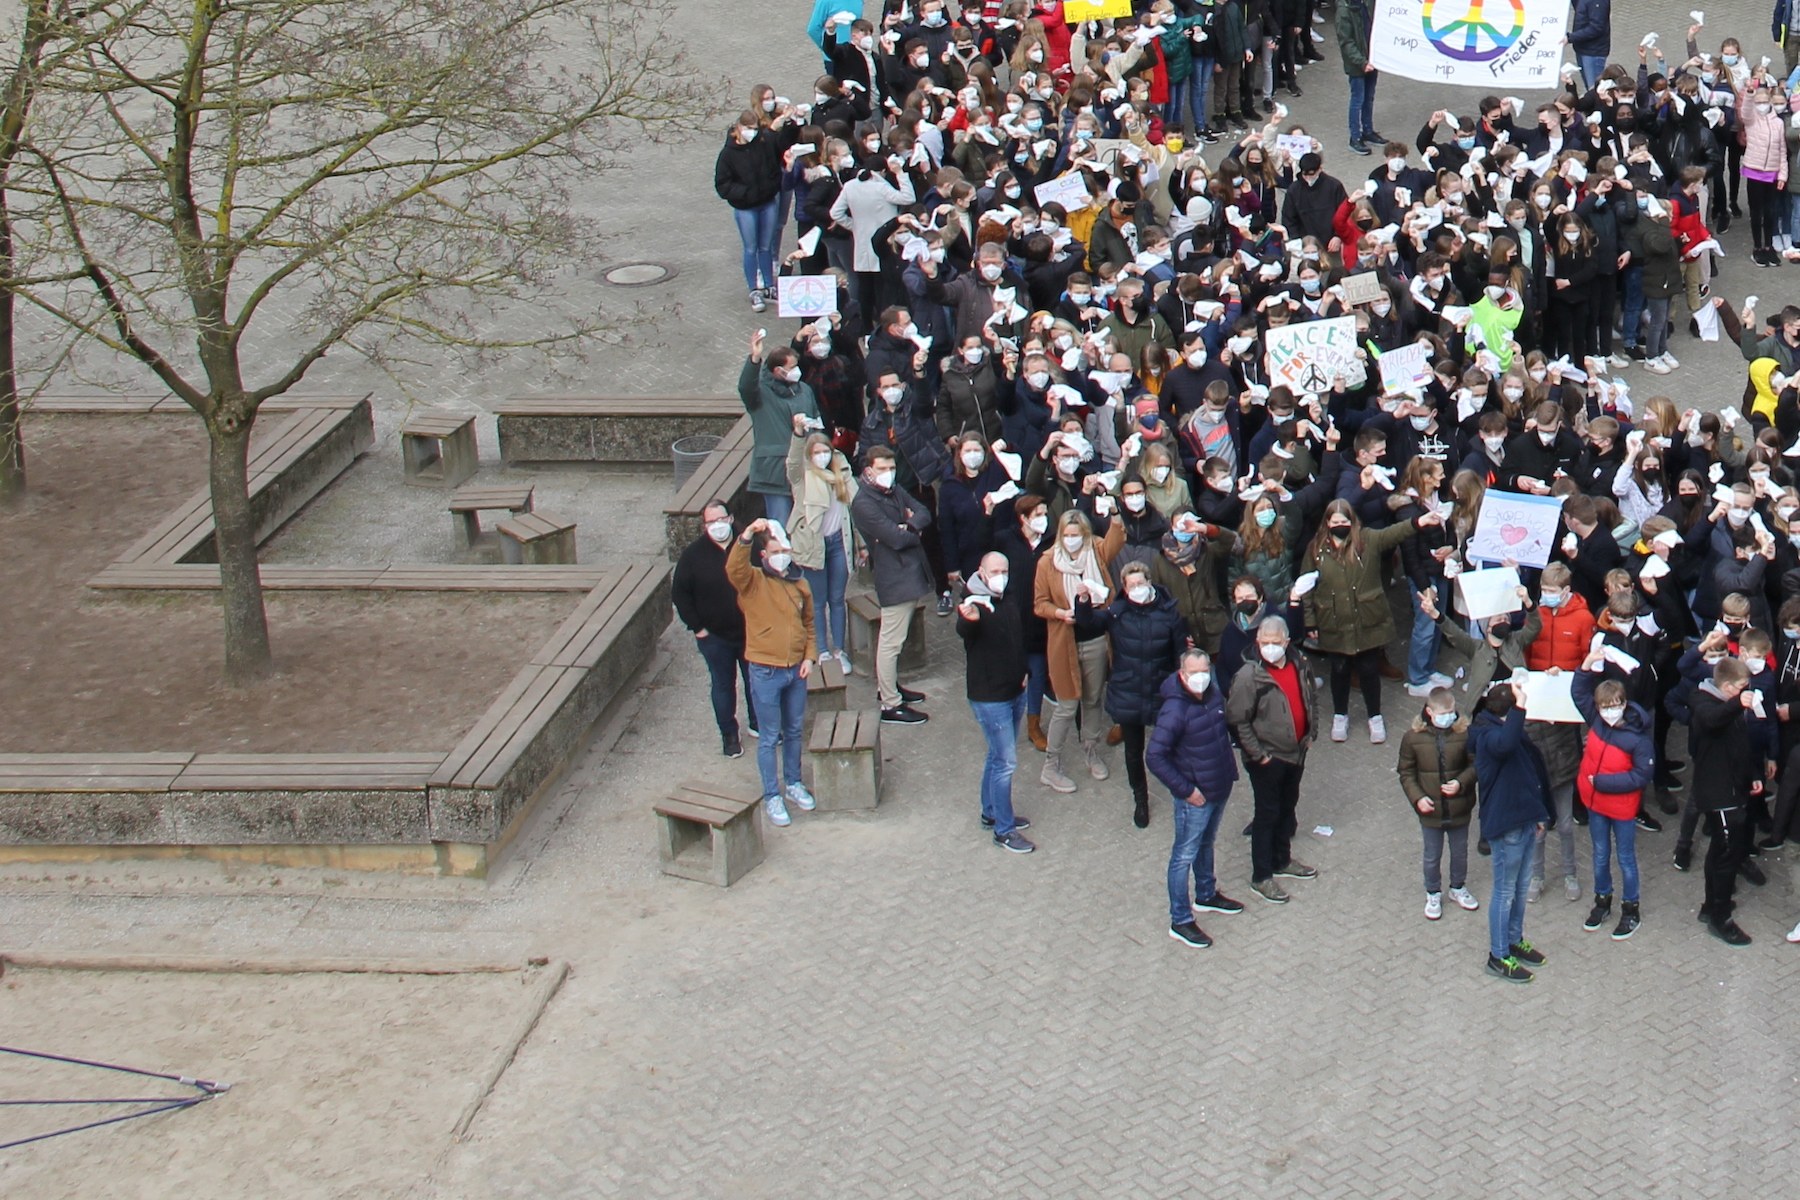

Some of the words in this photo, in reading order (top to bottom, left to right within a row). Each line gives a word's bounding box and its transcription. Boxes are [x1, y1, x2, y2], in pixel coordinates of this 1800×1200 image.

[1389, 6, 1409, 18] paix
[1541, 14, 1559, 26] pax
[1488, 29, 1541, 79] Frieden
[1536, 49, 1556, 60] pace
[1344, 278, 1380, 300] Frieden
[1270, 325, 1338, 365] PEACE
[1279, 351, 1312, 382] FOR
[1380, 342, 1424, 376] FRIEDEN
